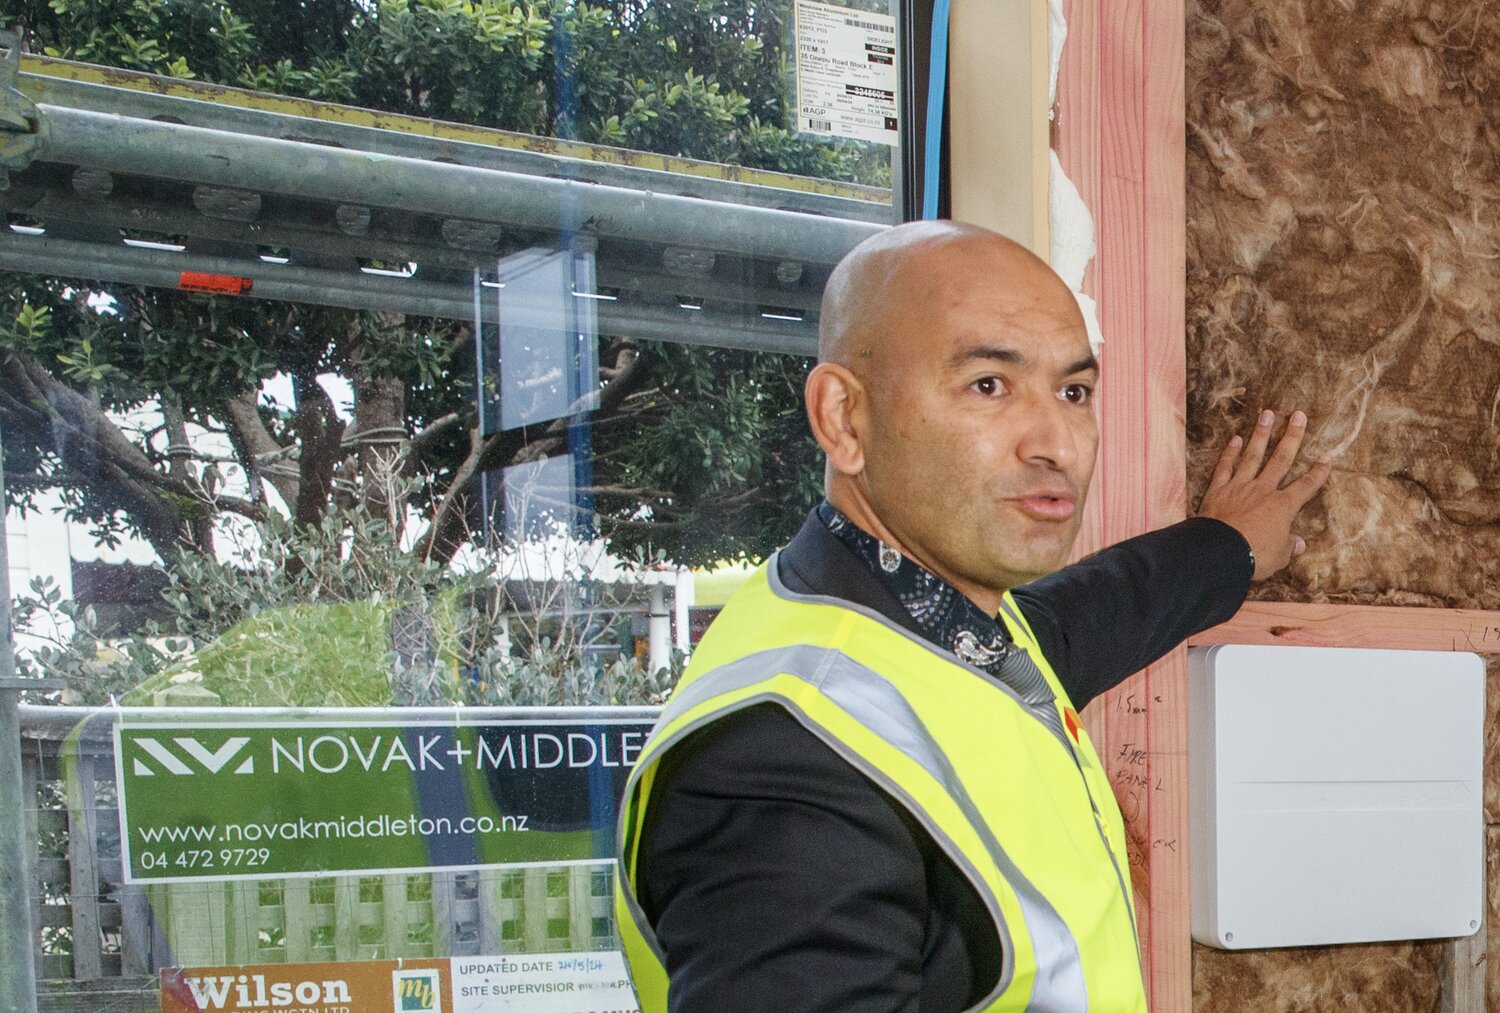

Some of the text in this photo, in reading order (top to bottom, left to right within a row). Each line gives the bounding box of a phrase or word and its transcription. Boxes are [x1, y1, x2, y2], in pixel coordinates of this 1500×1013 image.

[800, 44, 822, 53] ITEM:
[832, 58, 848, 67] Road
[849, 60, 868, 70] Block
[809, 107, 826, 116] AGP
[272, 732, 652, 774] NOVAK+MIDDLE
[139, 814, 529, 843] www.novakmiddleton.co.nz
[141, 848, 270, 869] 04 472 9729
[460, 962, 518, 975] UPDATED
[522, 961, 553, 973] DATE
[184, 974, 352, 1010] Wilson
[461, 986, 489, 997] SITE
[492, 983, 574, 995] SUPERVISIOR
